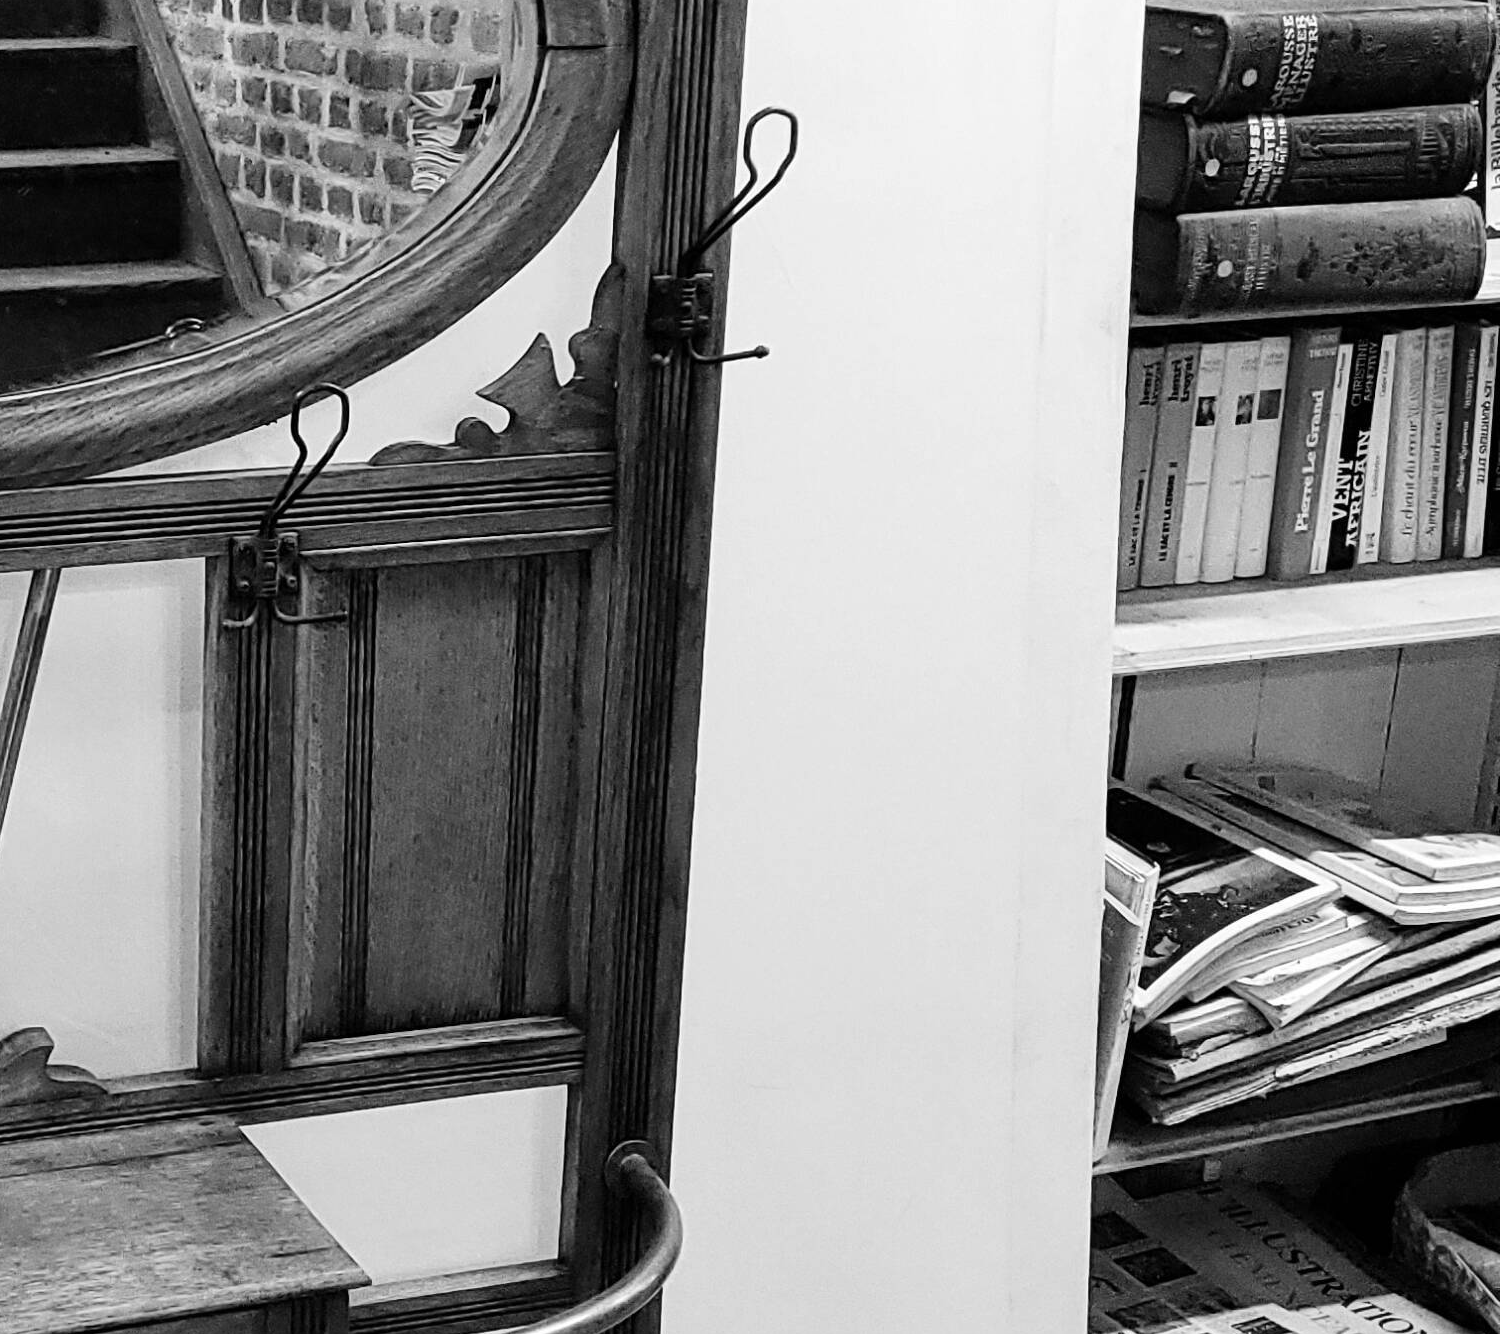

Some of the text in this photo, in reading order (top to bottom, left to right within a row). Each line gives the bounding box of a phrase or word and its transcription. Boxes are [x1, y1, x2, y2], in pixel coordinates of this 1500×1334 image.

[1269, 15, 1295, 109] AROUSSE
[1139, 363, 1153, 406] henri
[1167, 359, 1182, 402] henri
[1180, 355, 1195, 403] troyat
[1305, 389, 1326, 448] Grand
[1301, 451, 1318, 474] Le
[1294, 475, 1316, 533] Pierre
[1331, 457, 1354, 523] VENT
[1345, 430, 1372, 548] AFRICAIN
[1129, 539, 1139, 554] SAC
[1159, 533, 1170, 550] SAC
